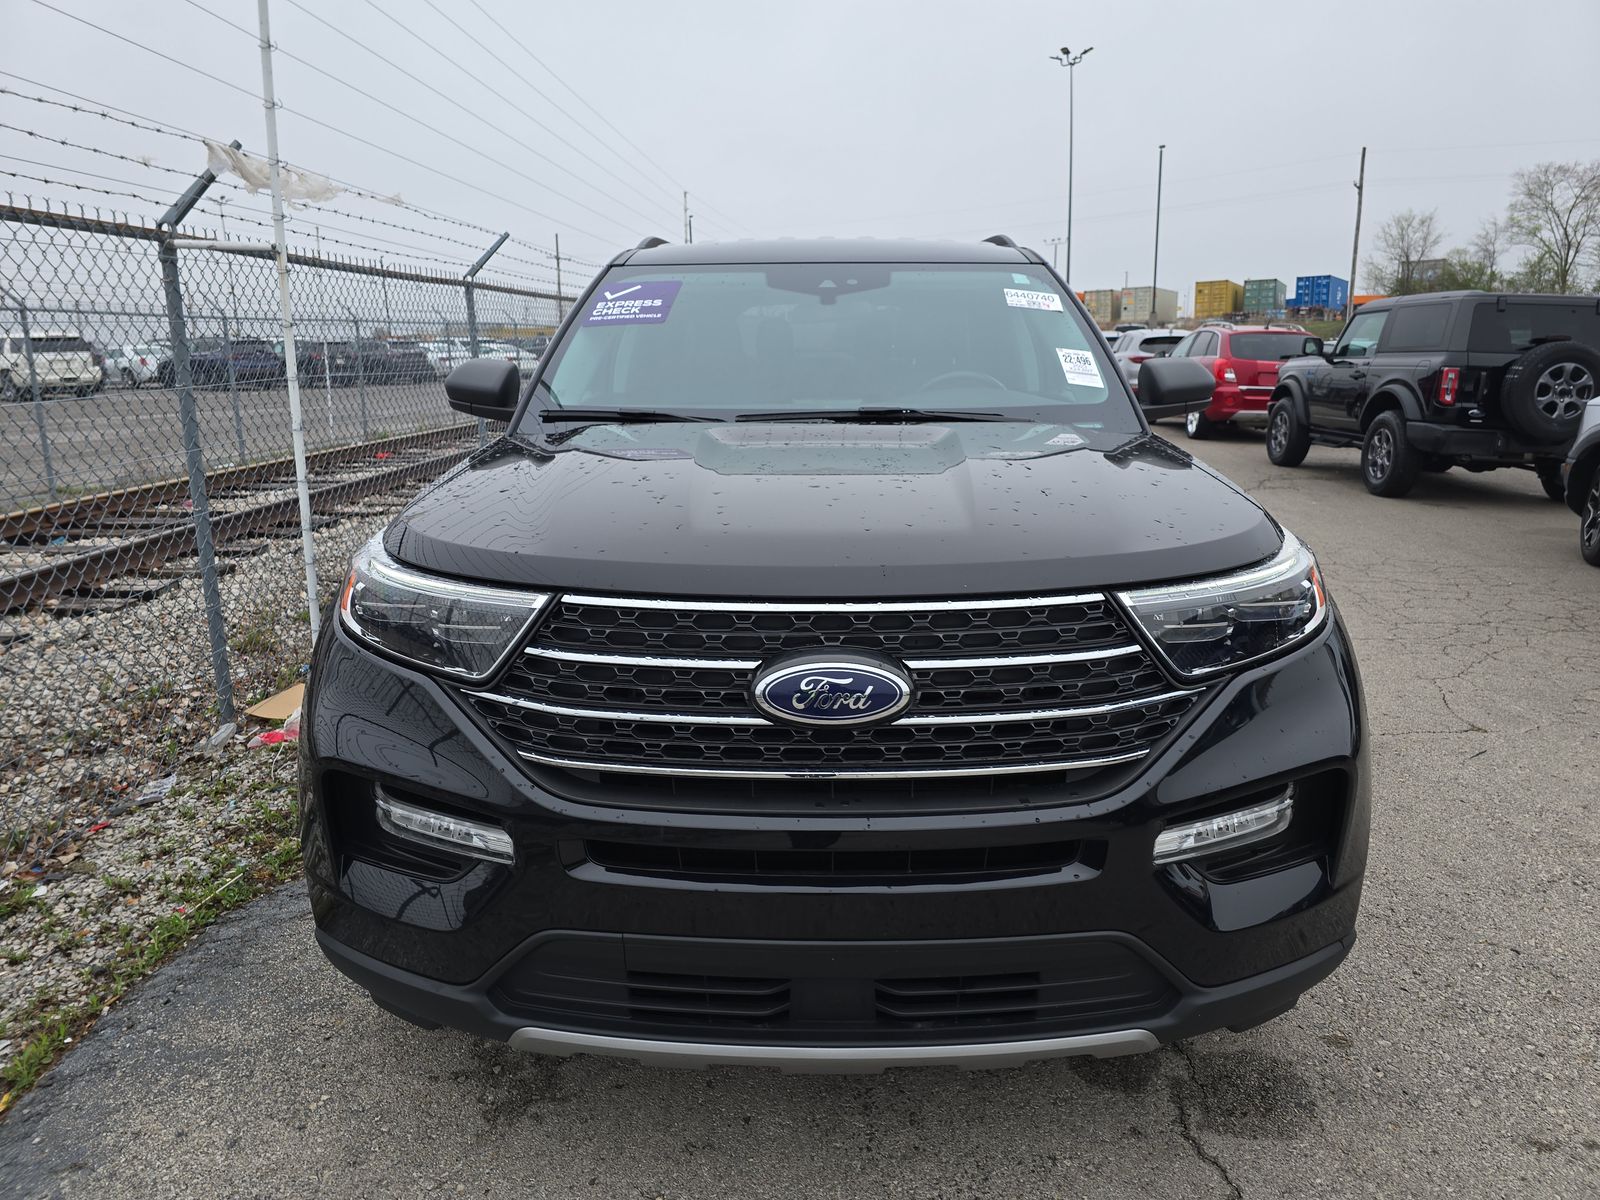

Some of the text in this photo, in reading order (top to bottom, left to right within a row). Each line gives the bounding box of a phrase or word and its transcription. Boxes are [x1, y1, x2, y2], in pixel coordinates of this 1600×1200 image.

[1006, 291, 1054, 302] 6440740
[596, 299, 662, 308] EXPRESS
[592, 307, 640, 315] CHECK
[792, 676, 874, 710] Ford
